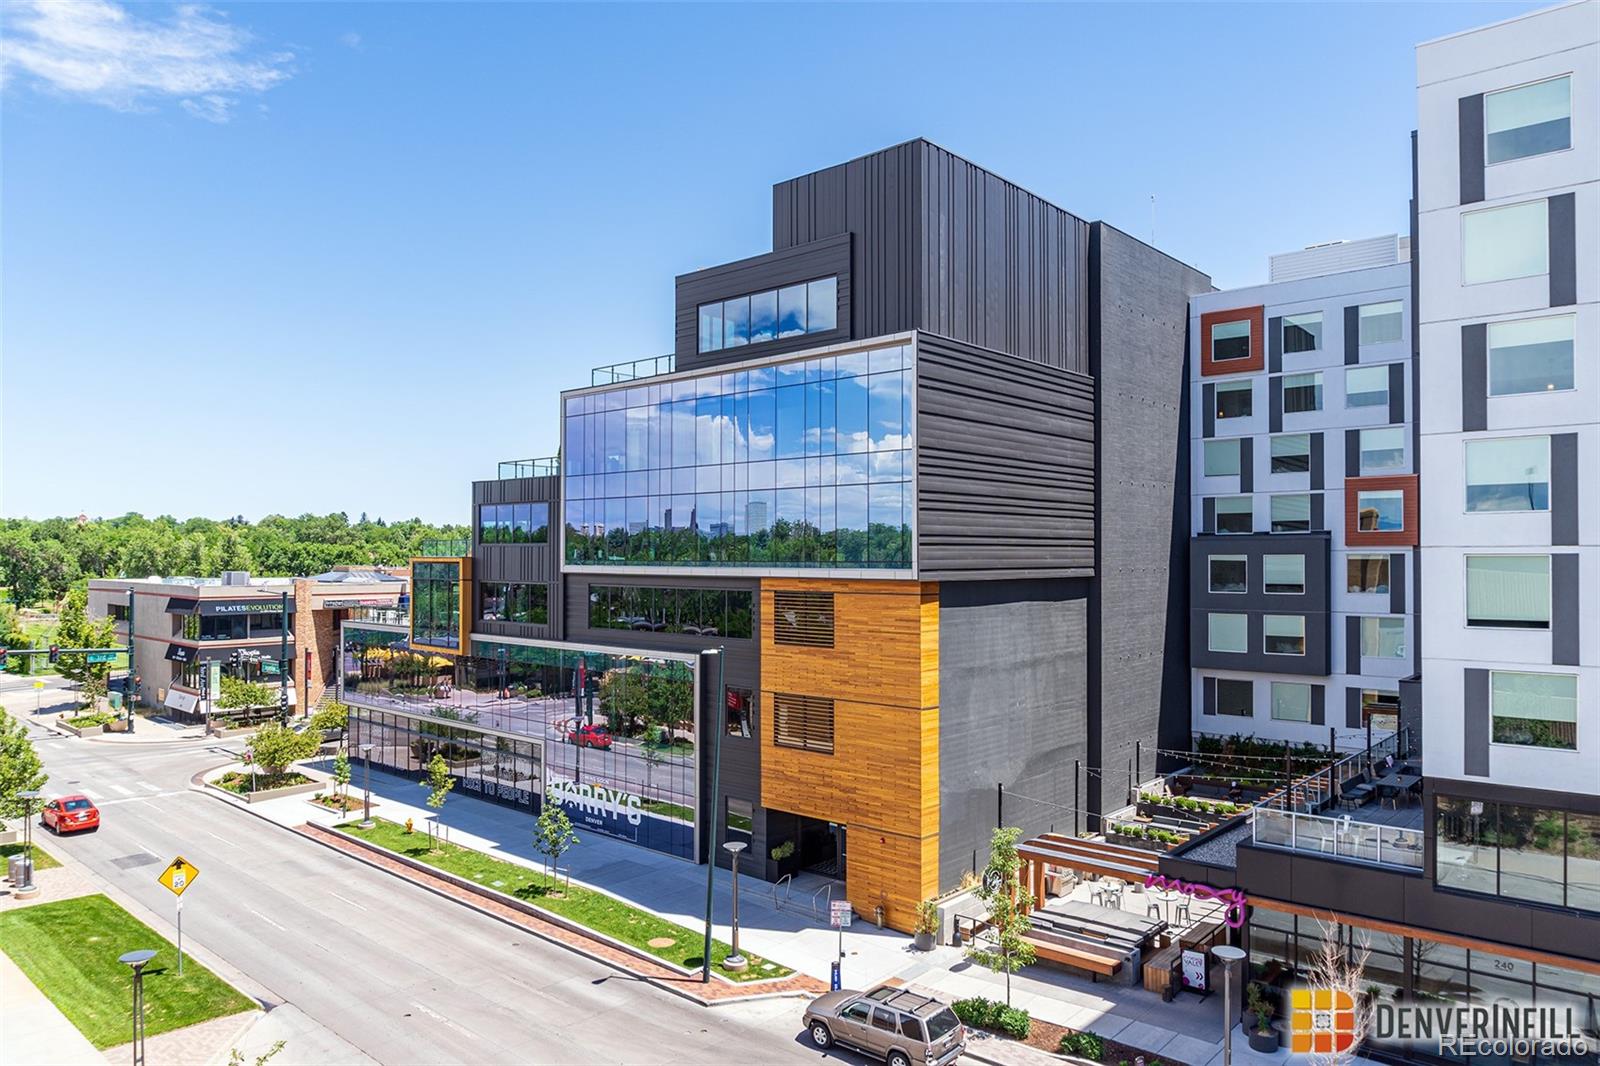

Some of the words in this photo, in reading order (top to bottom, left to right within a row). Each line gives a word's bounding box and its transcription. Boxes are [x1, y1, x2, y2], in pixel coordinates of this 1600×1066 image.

[483, 780, 495, 796] TO
[585, 816, 603, 826] DENVER
[1494, 959, 1514, 971] 240
